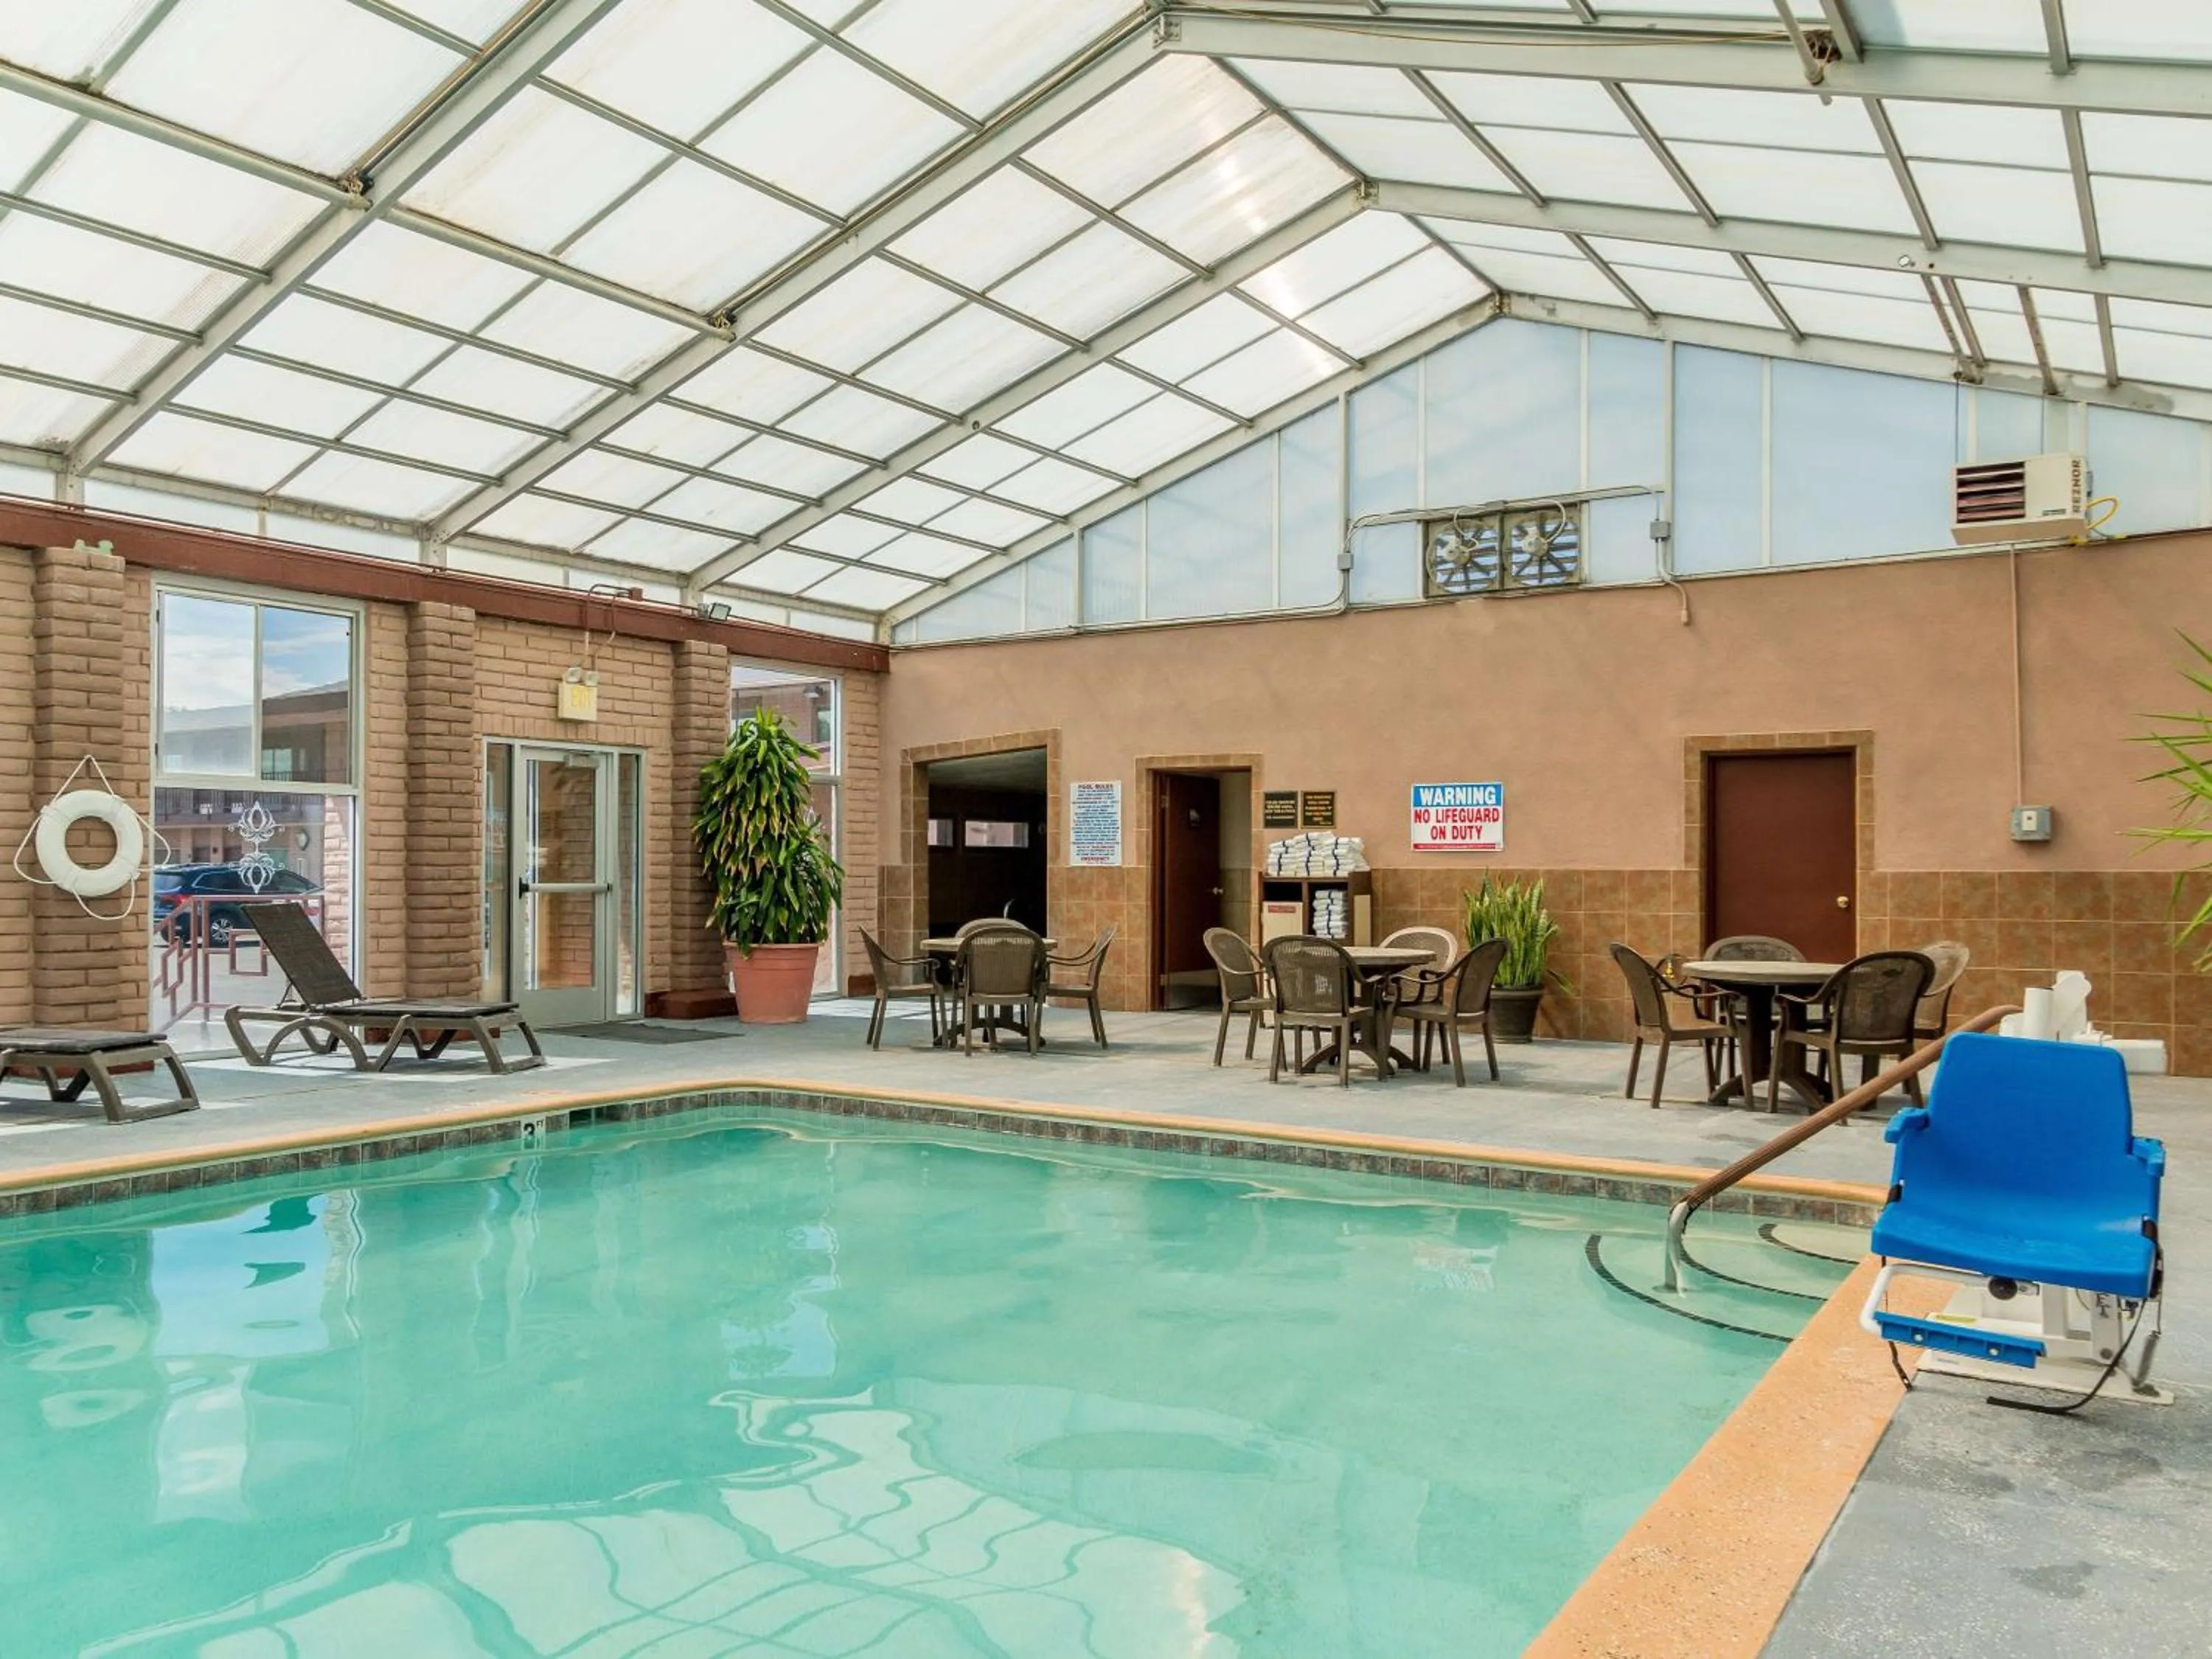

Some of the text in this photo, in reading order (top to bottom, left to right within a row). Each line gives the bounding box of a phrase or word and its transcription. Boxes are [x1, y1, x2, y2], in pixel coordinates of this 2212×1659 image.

[2071, 459, 2081, 513] REZNOR
[1419, 786, 1496, 806] WARNING
[1414, 807, 1500, 824] NO LIFEGUARD
[1430, 825, 1483, 841] ON DUTY
